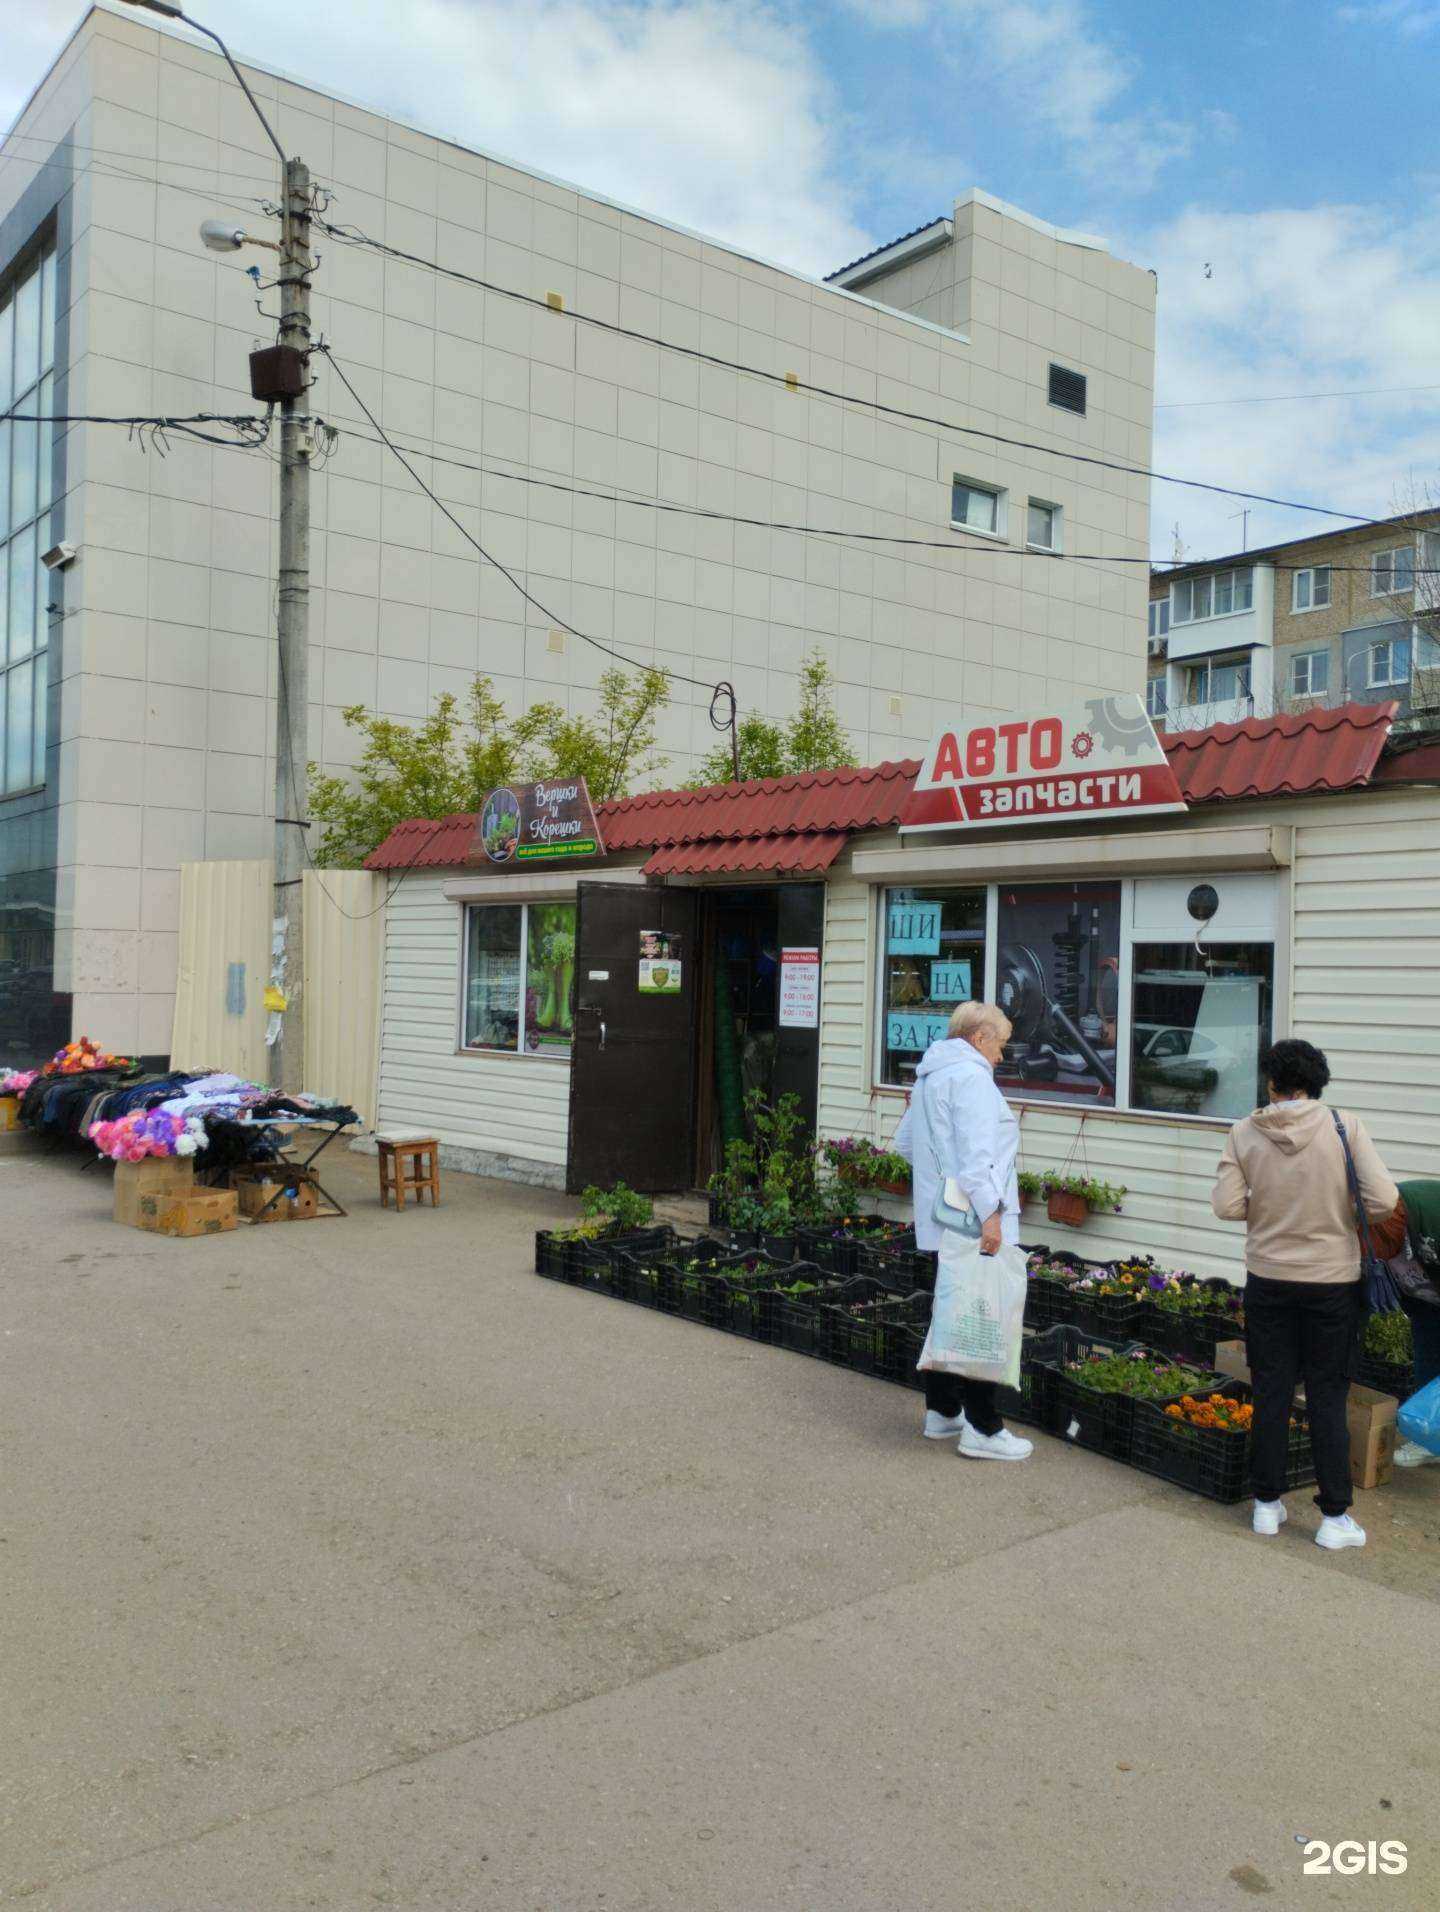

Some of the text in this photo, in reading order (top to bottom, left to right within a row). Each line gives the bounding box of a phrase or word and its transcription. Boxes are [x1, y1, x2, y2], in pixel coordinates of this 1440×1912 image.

[931, 717, 1063, 782] АВТО
[535, 784, 578, 812] Вершки
[980, 773, 1141, 813] запчасти
[529, 816, 582, 845] Корешки
[891, 914, 936, 939] ШИ
[935, 973, 966, 994] НА
[892, 1023, 941, 1048] ЗАК
